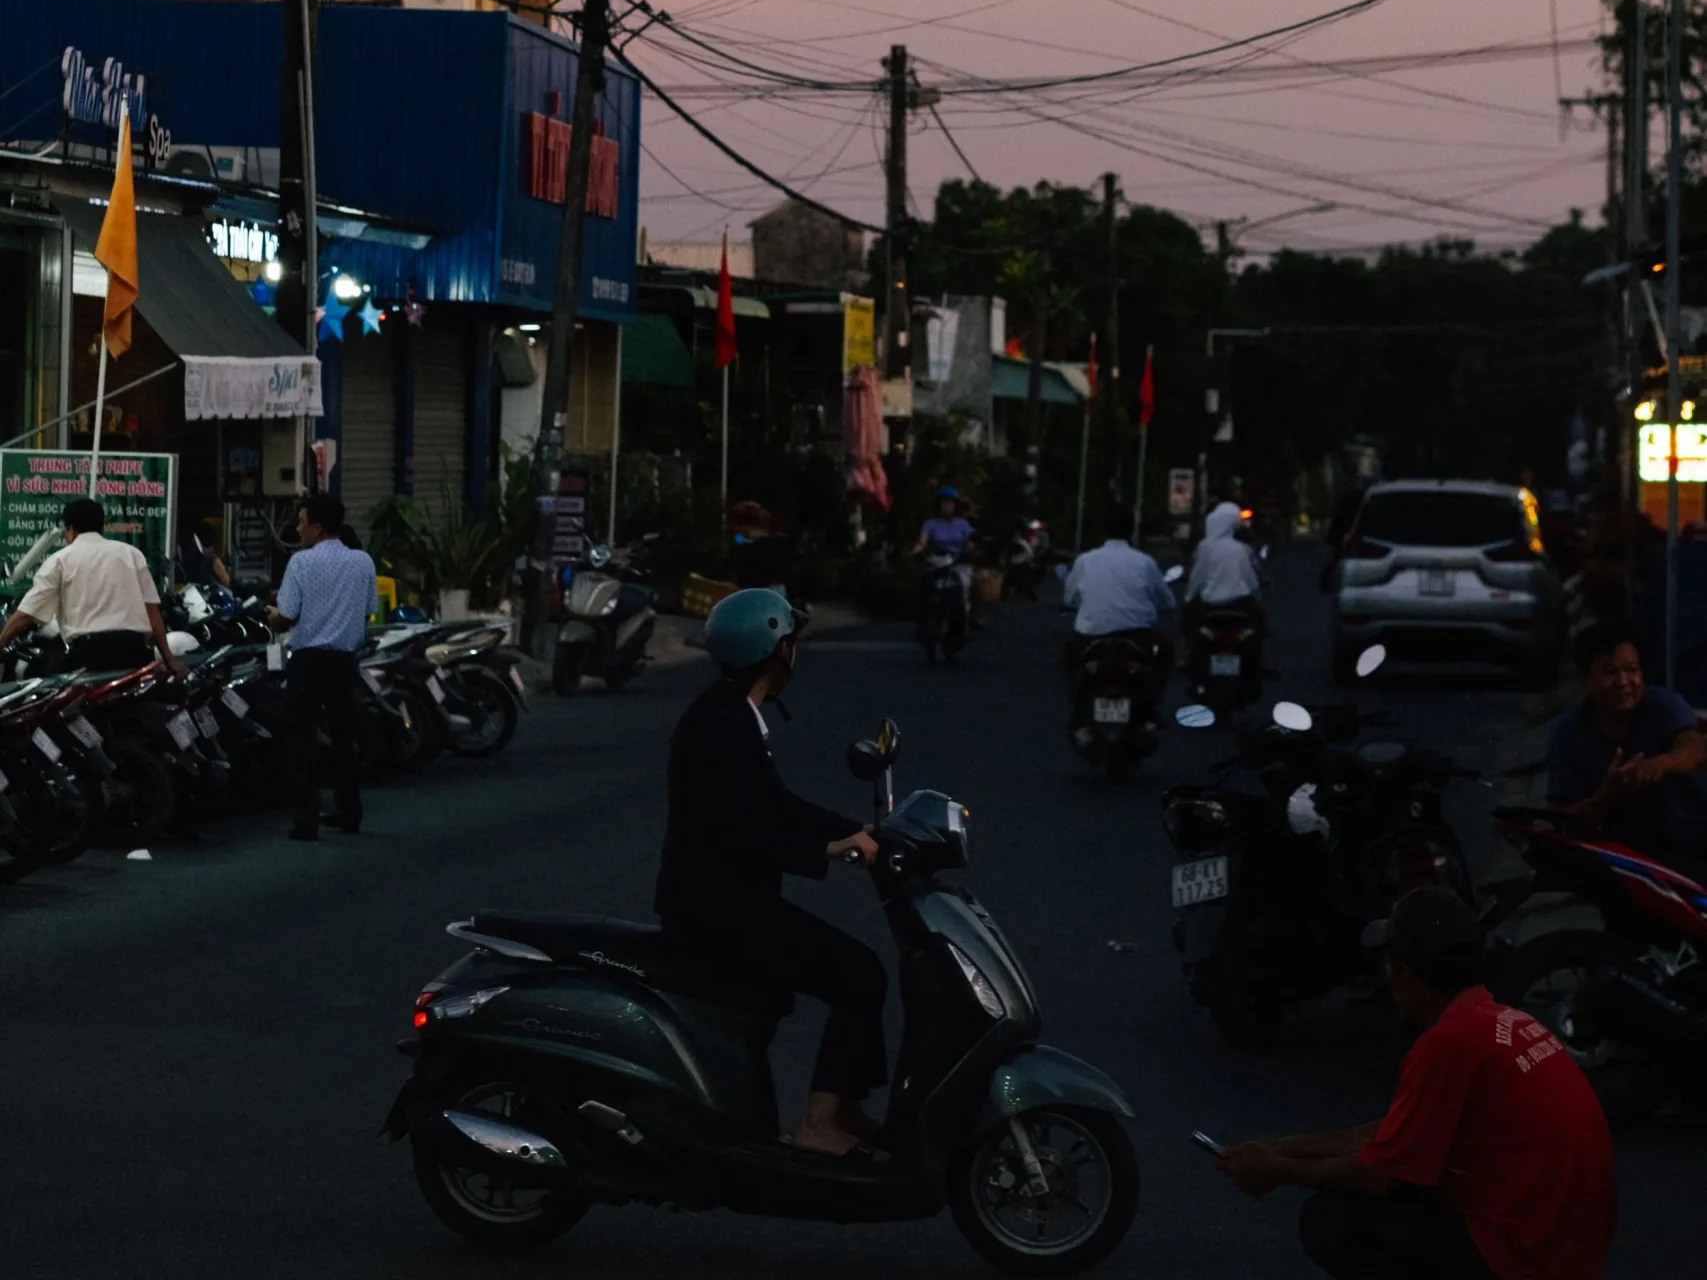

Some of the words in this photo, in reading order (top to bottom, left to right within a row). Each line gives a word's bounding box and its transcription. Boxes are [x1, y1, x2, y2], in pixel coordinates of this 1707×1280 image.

[149, 113, 171, 161] Spa
[268, 363, 299, 397] Spa
[28, 457, 72, 473] TRUNG
[578, 951, 645, 977] Grande
